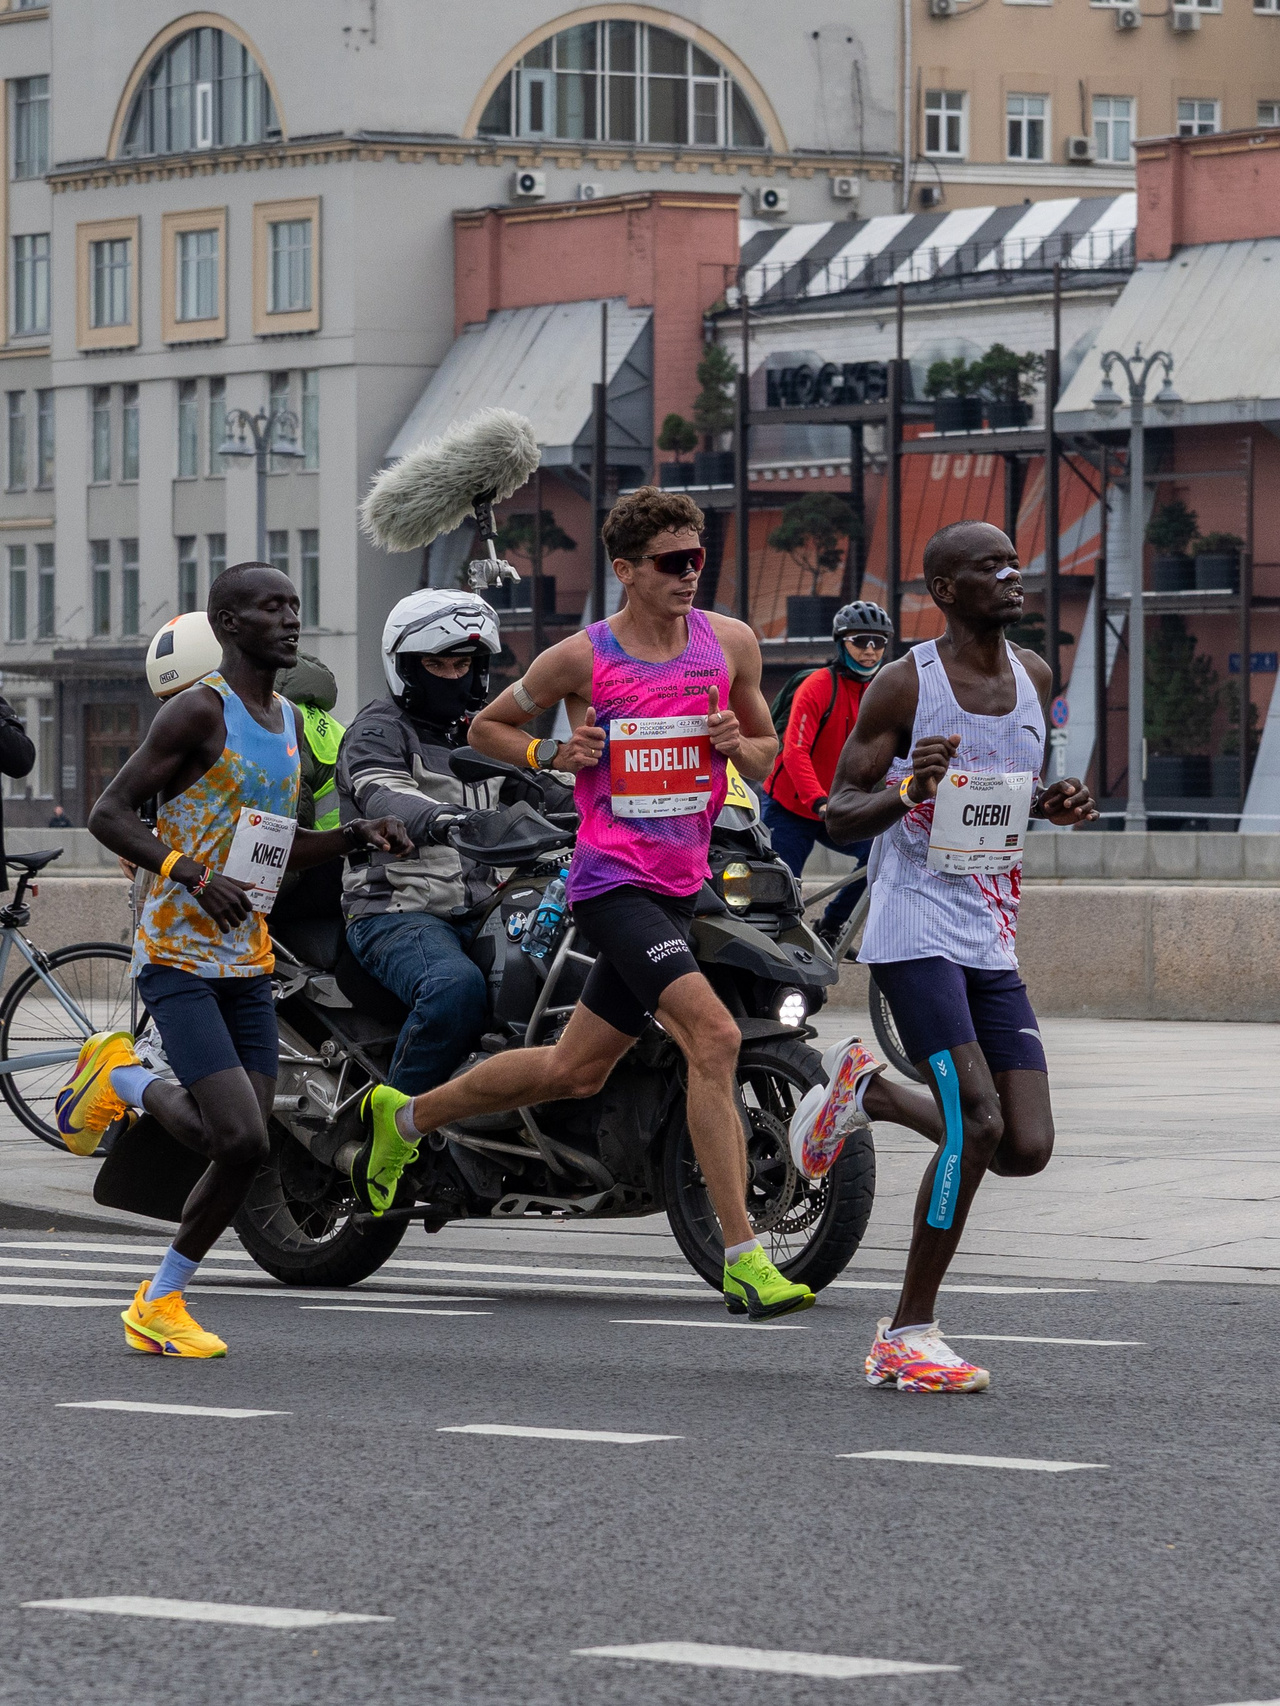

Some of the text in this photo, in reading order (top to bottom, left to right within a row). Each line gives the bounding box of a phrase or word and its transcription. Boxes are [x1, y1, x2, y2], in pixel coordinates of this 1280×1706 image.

[684, 669, 720, 678] FONBET
[595, 676, 644, 689] TENET
[658, 692, 678, 700] sport
[624, 746, 700, 772] NEDELIN
[663, 780, 668, 789] 1
[962, 804, 1011, 826] CHEBII
[979, 837, 985, 846] 5
[260, 876, 266, 885] 2
[651, 946, 682, 963] WATCH
[937, 1154, 958, 1221] RAVETAPE
